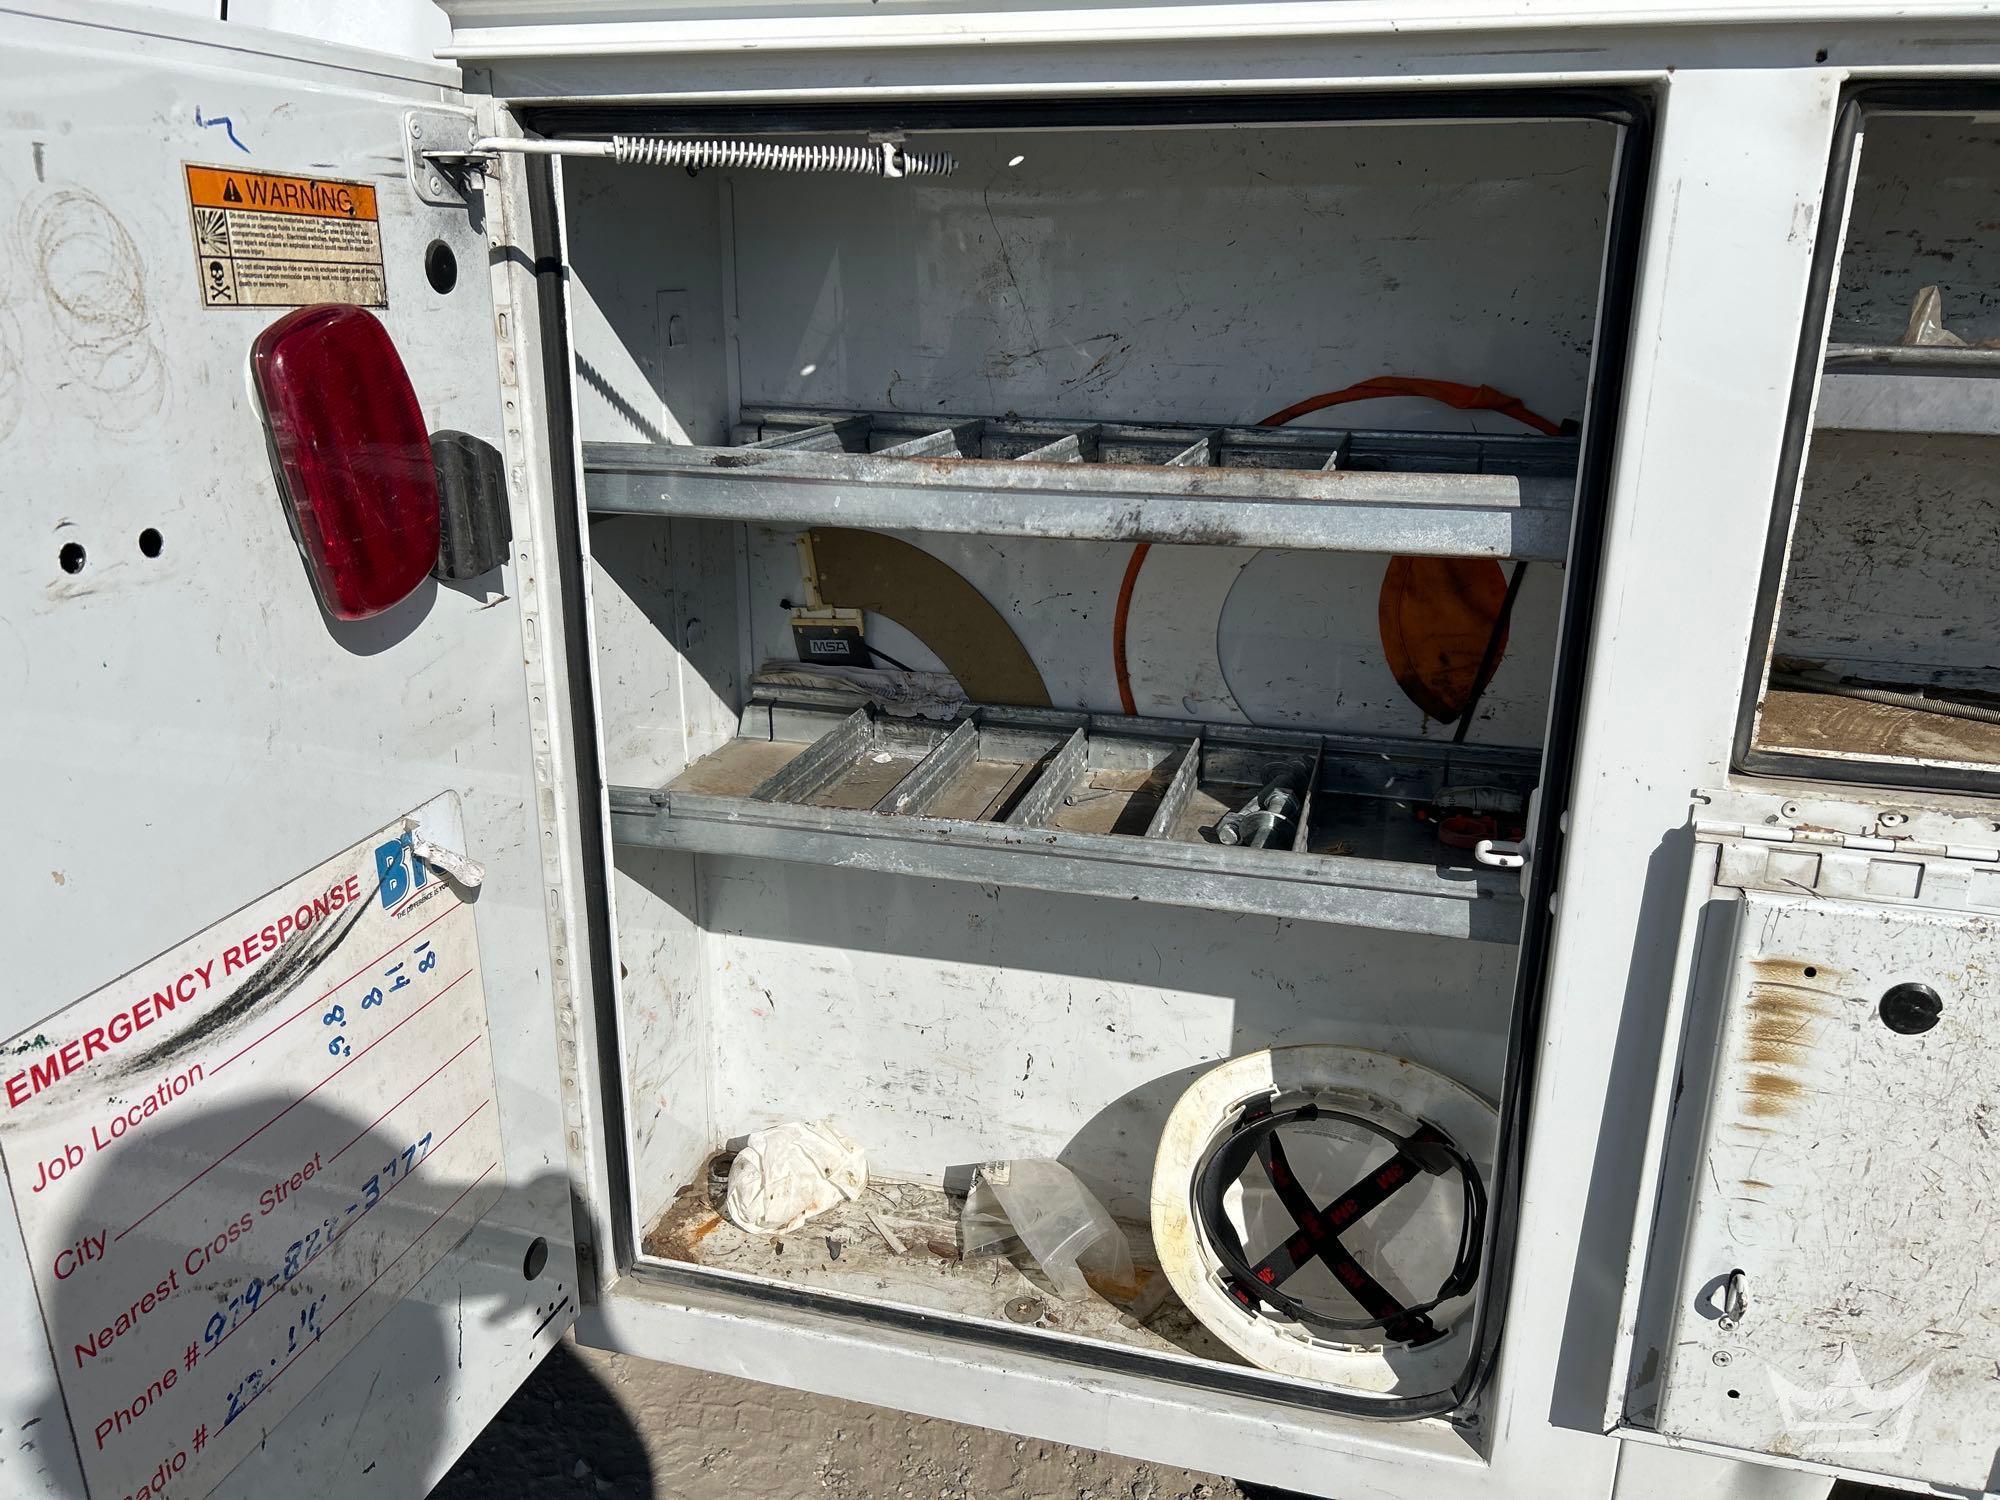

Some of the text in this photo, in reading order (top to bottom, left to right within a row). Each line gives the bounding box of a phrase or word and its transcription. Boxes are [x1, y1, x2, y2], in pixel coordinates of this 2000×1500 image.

[246, 178, 351, 213] WARNING
[813, 641, 848, 652] MSA
[396, 905, 407, 920] THE
[406, 892, 434, 914] DIFFERENCE
[433, 887, 440, 896] IS
[3, 874, 361, 1109] EMERGENCY RESPONSE
[32, 1060, 203, 1194] Job Location
[53, 1228, 108, 1281] City
[74, 1152, 322, 1369] Nearest Cross Street
[94, 1341, 200, 1450] Phone #
[123, 1423, 208, 1500] adio #
